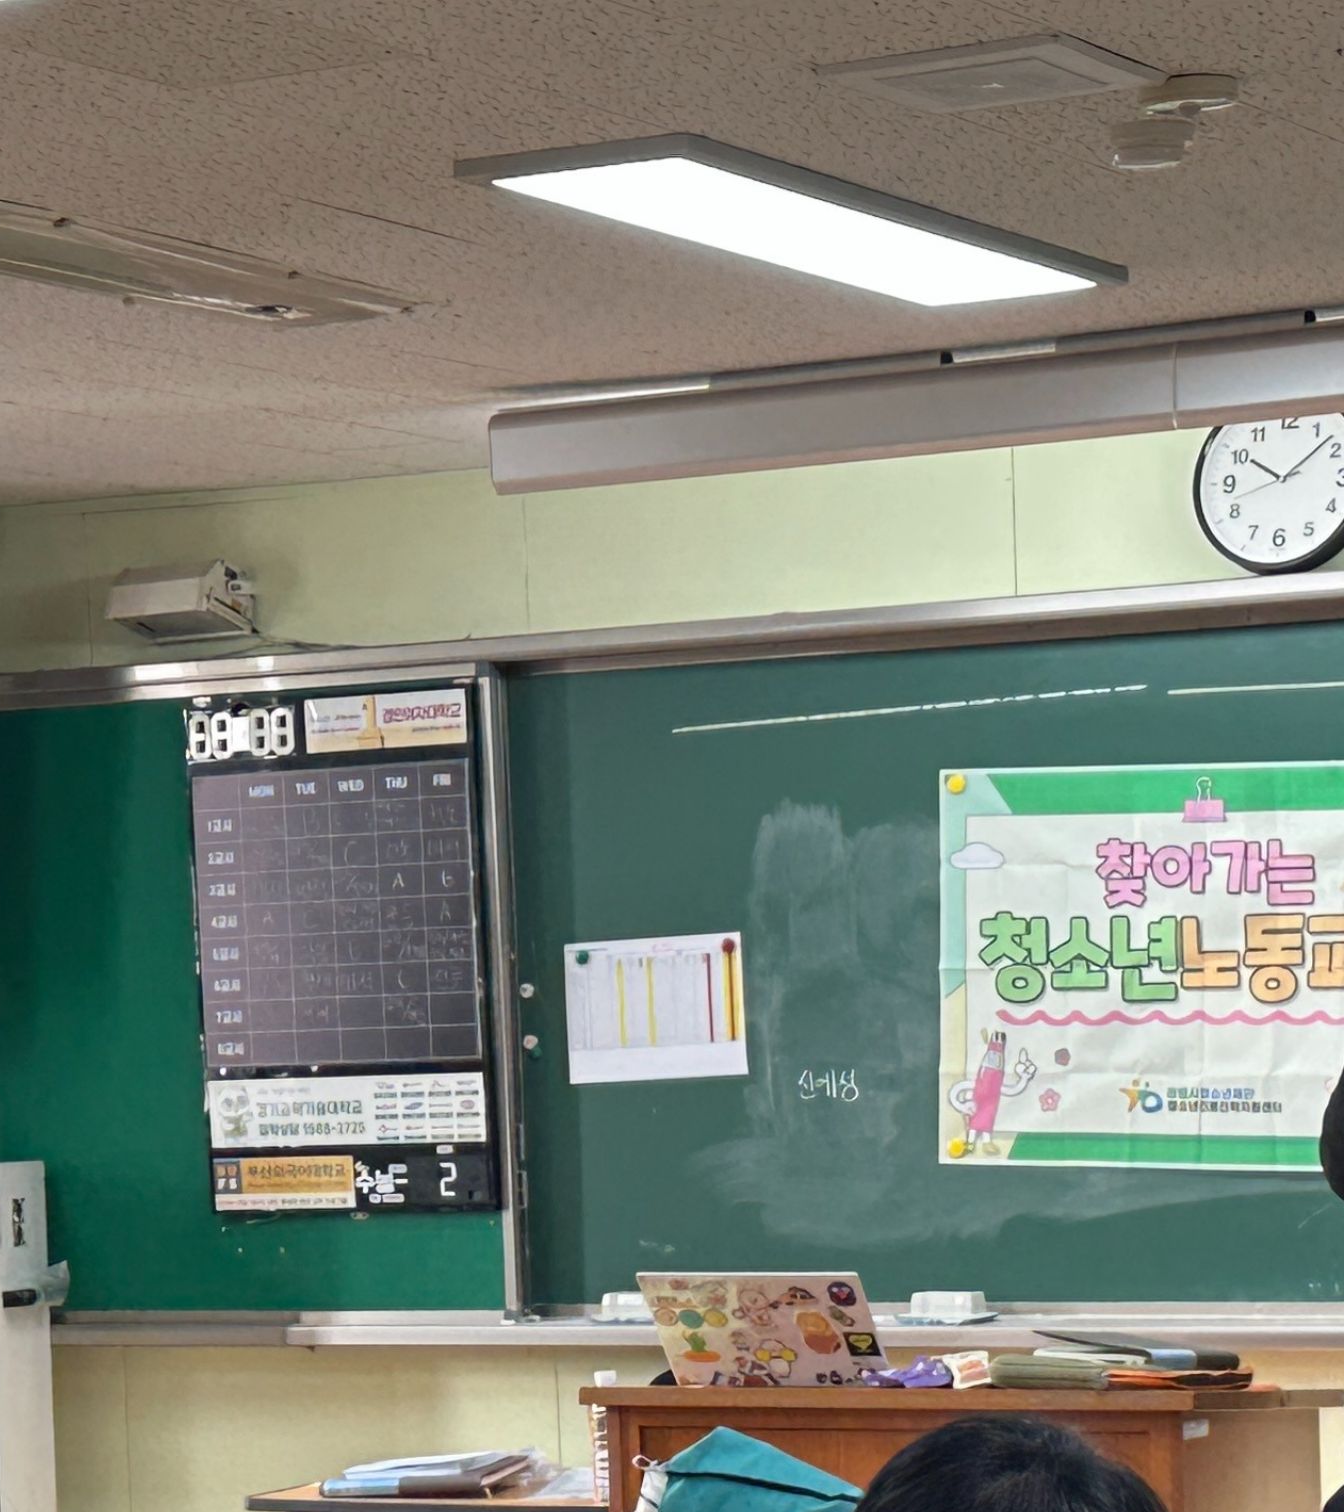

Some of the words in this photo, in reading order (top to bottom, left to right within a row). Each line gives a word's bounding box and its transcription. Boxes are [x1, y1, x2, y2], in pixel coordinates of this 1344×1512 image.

[1251, 426, 1266, 442] 11
[1231, 448, 1249, 464] 10
[1329, 443, 1342, 458] 2
[1223, 475, 1236, 493] 9
[1229, 503, 1240, 518] 8
[1325, 498, 1337, 513] 4
[1248, 525, 1259, 540] 7
[1303, 522, 1314, 536] 5
[1272, 528, 1286, 547] 6
[385, 776, 408, 789] THU
[1095, 837, 1316, 908] 찾아가는
[440, 1162, 457, 1196] 2
